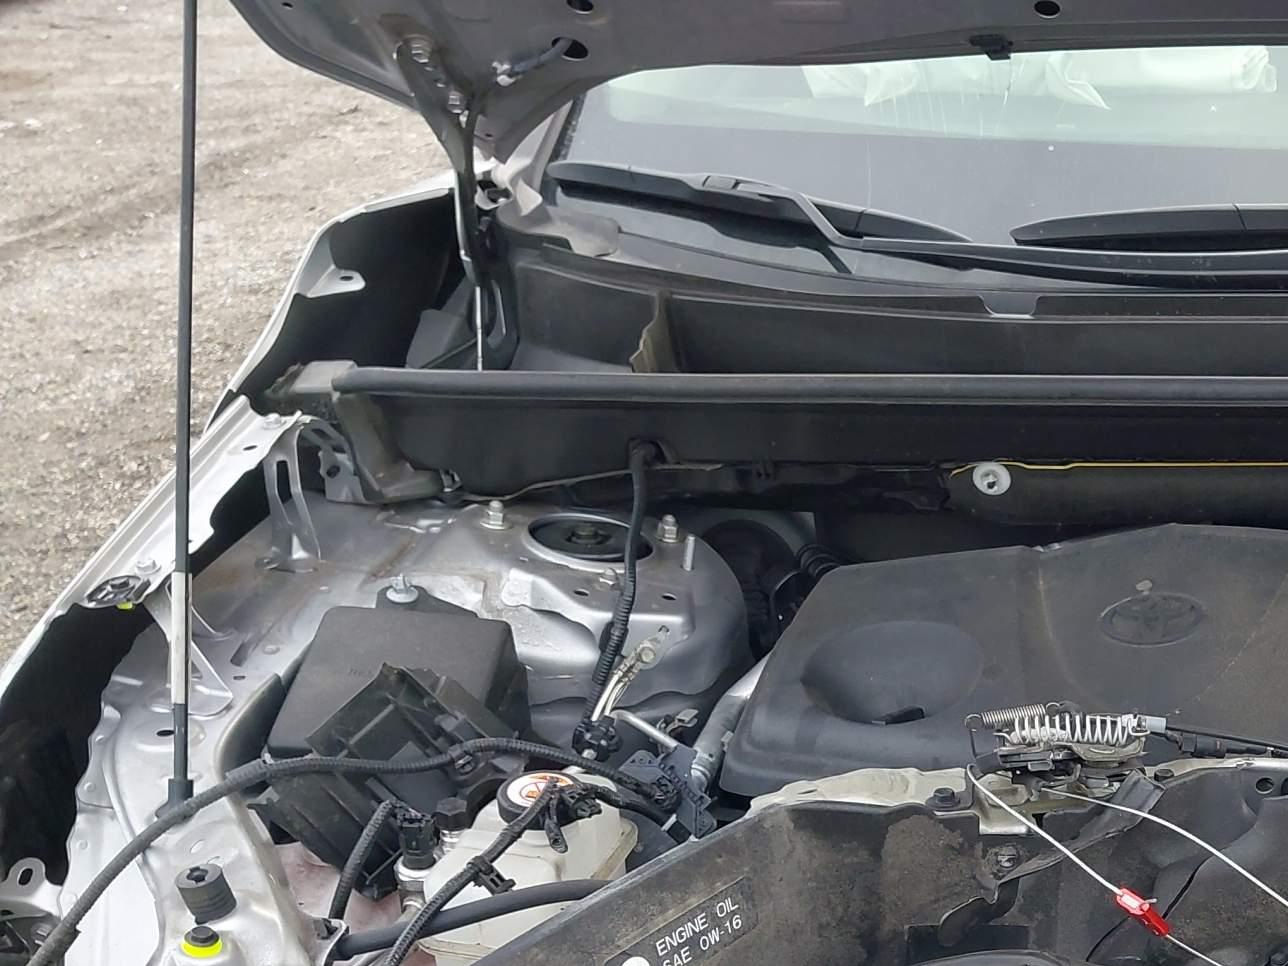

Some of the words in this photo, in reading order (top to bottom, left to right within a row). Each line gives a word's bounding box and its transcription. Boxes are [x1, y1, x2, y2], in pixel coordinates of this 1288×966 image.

[655, 912, 709, 956] ENGINE
[716, 897, 739, 918] OIL
[700, 915, 742, 951] 0W-16
